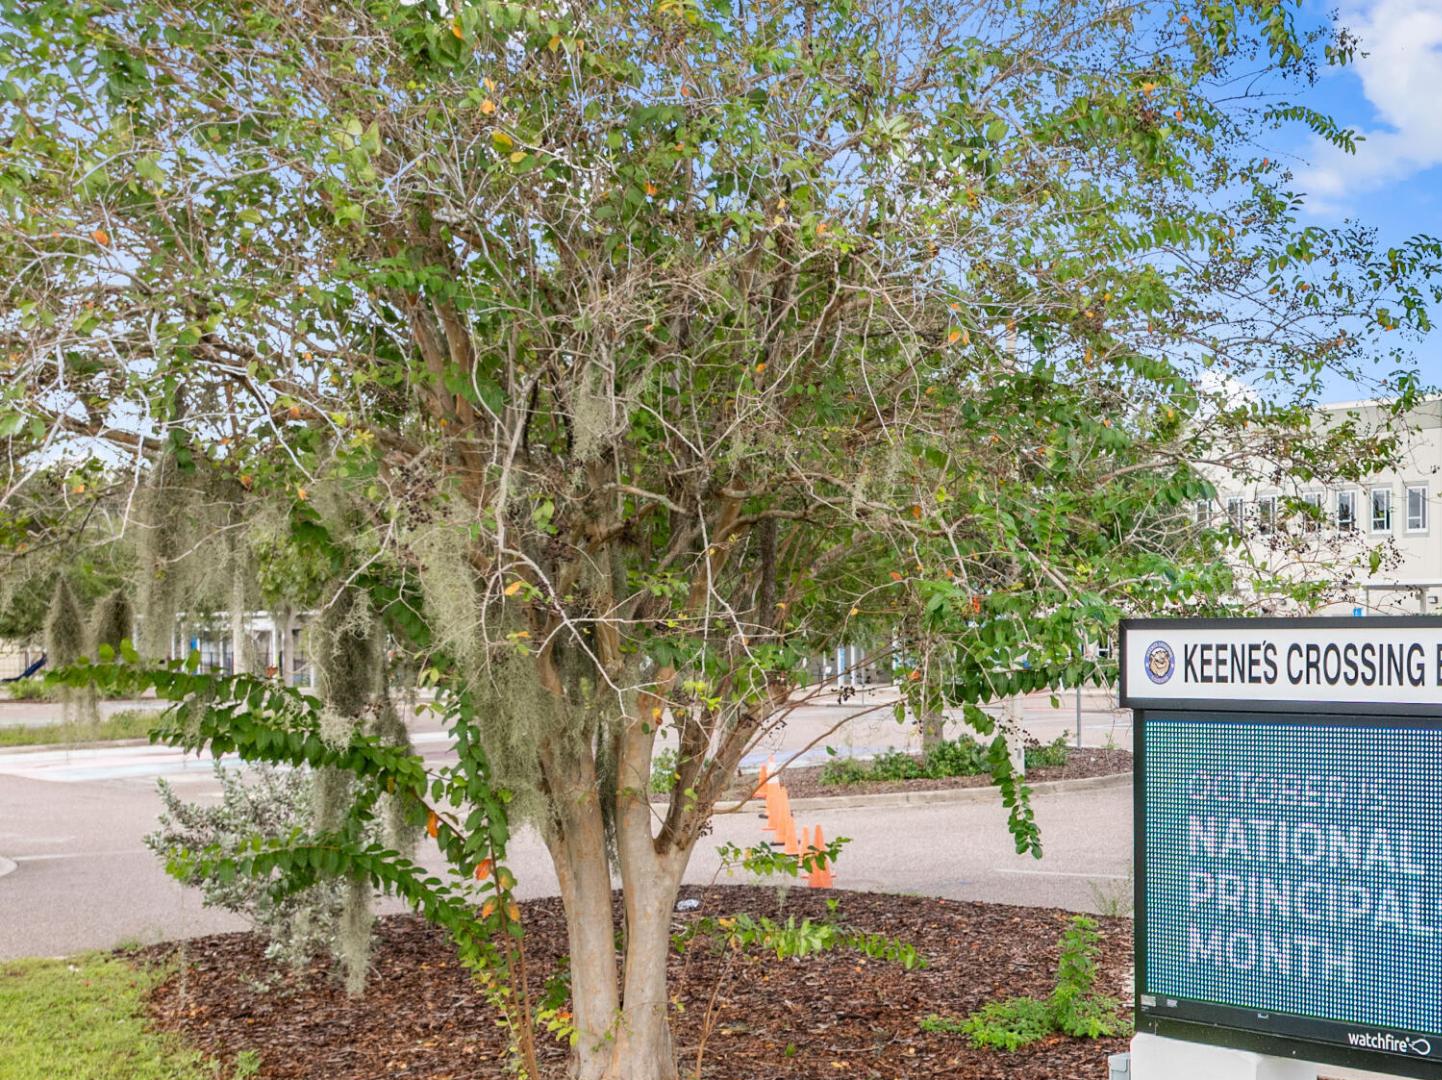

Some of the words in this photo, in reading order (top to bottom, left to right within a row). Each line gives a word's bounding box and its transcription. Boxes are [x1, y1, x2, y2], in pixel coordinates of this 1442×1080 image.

[1183, 640, 1279, 685] KEENE'S
[1286, 642, 1426, 688] CROSSING
[1188, 769, 1347, 808] OCTOBER
[1358, 777, 1389, 811] IS
[1188, 813, 1426, 876] NATIONAL
[1188, 923, 1355, 985] MONTH
[1347, 1031, 1408, 1053] watchfire
